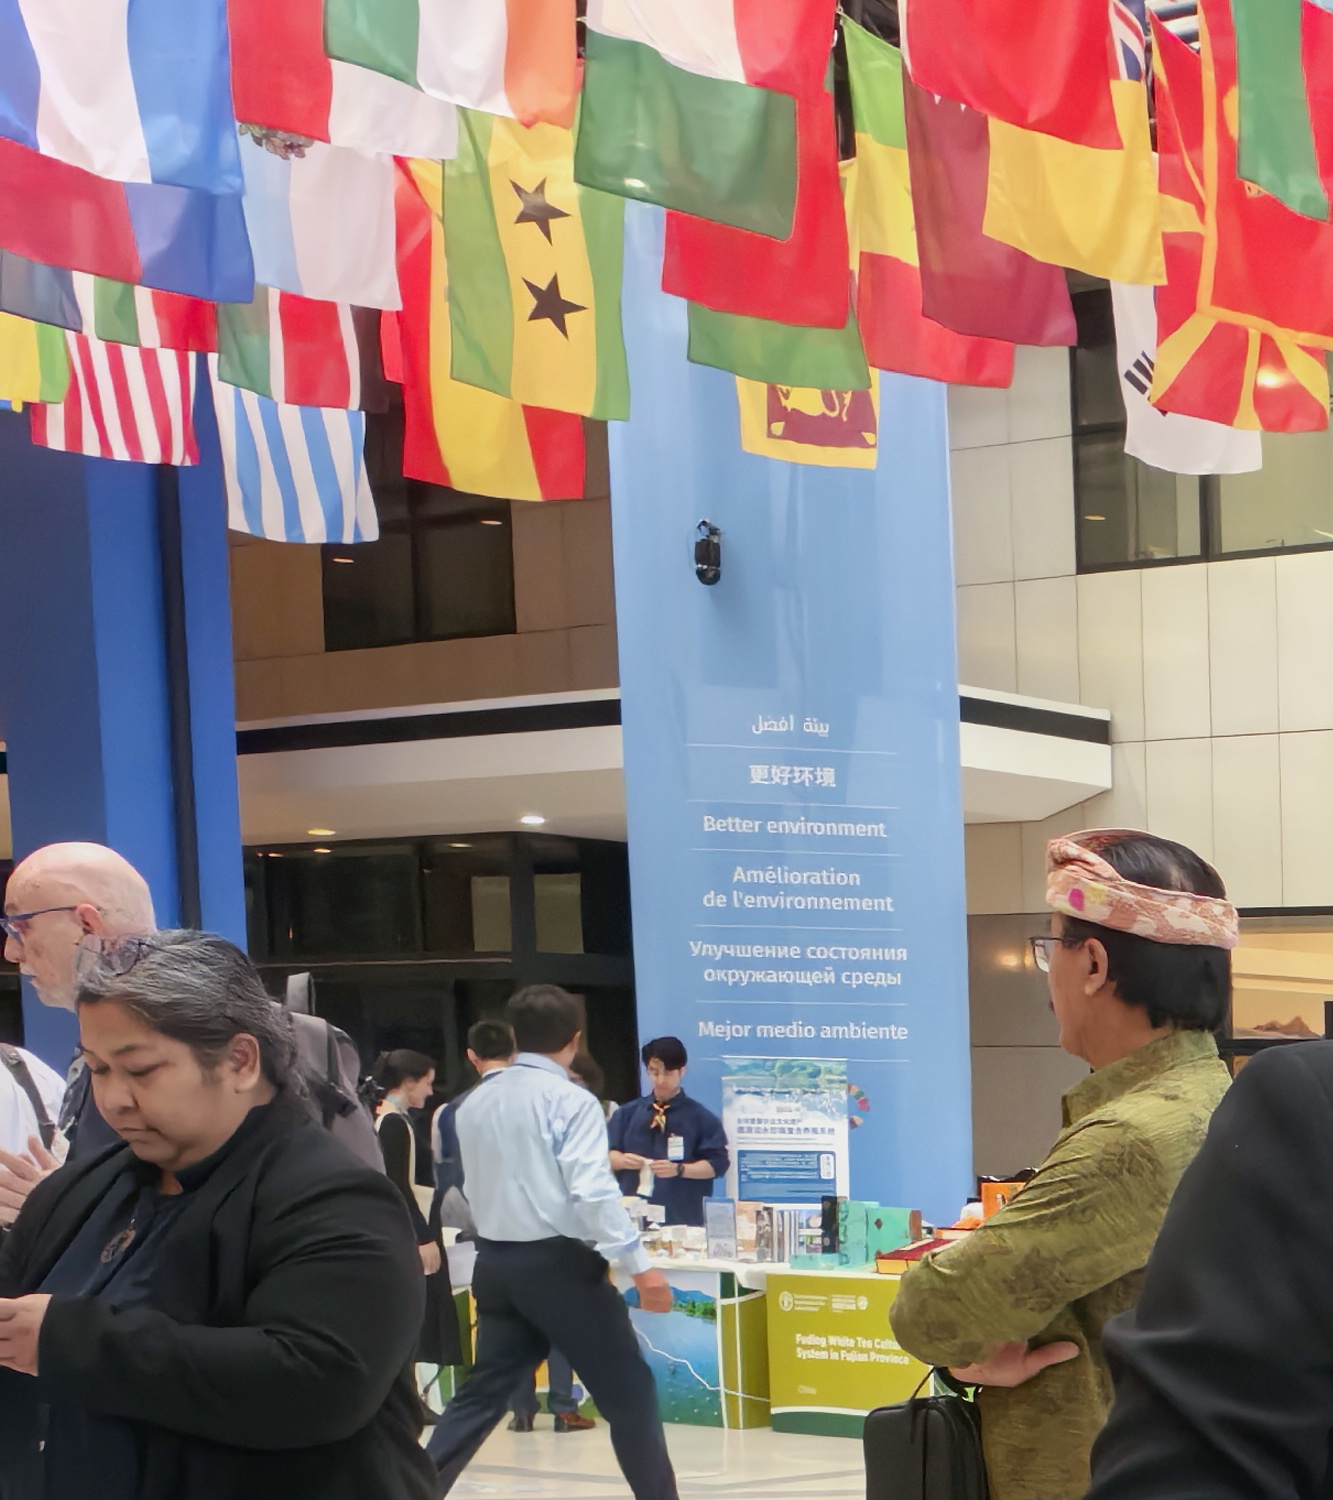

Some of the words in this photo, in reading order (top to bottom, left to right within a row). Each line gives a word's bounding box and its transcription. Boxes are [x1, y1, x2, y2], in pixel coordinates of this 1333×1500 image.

[748, 764, 837, 788] 更好环境
[703, 815, 762, 833] Better
[767, 816, 887, 838] environment
[732, 865, 861, 886] Amélioration
[702, 891, 727, 908] de
[732, 891, 894, 911] l'environnement
[689, 941, 801, 960] Улучшение
[806, 946, 908, 961] состояния
[704, 966, 836, 986] окружающей
[841, 971, 902, 988] среды
[698, 1020, 752, 1040] Mejor
[756, 1020, 816, 1038] medio
[820, 1022, 909, 1040] ambiente
[828, 1335, 856, 1348] White
[857, 1337, 873, 1349] Tea
[796, 1348, 829, 1360] System
[830, 1349, 840, 1360] in
[841, 1350, 869, 1363] Fujian
[870, 1352, 910, 1365] Province
